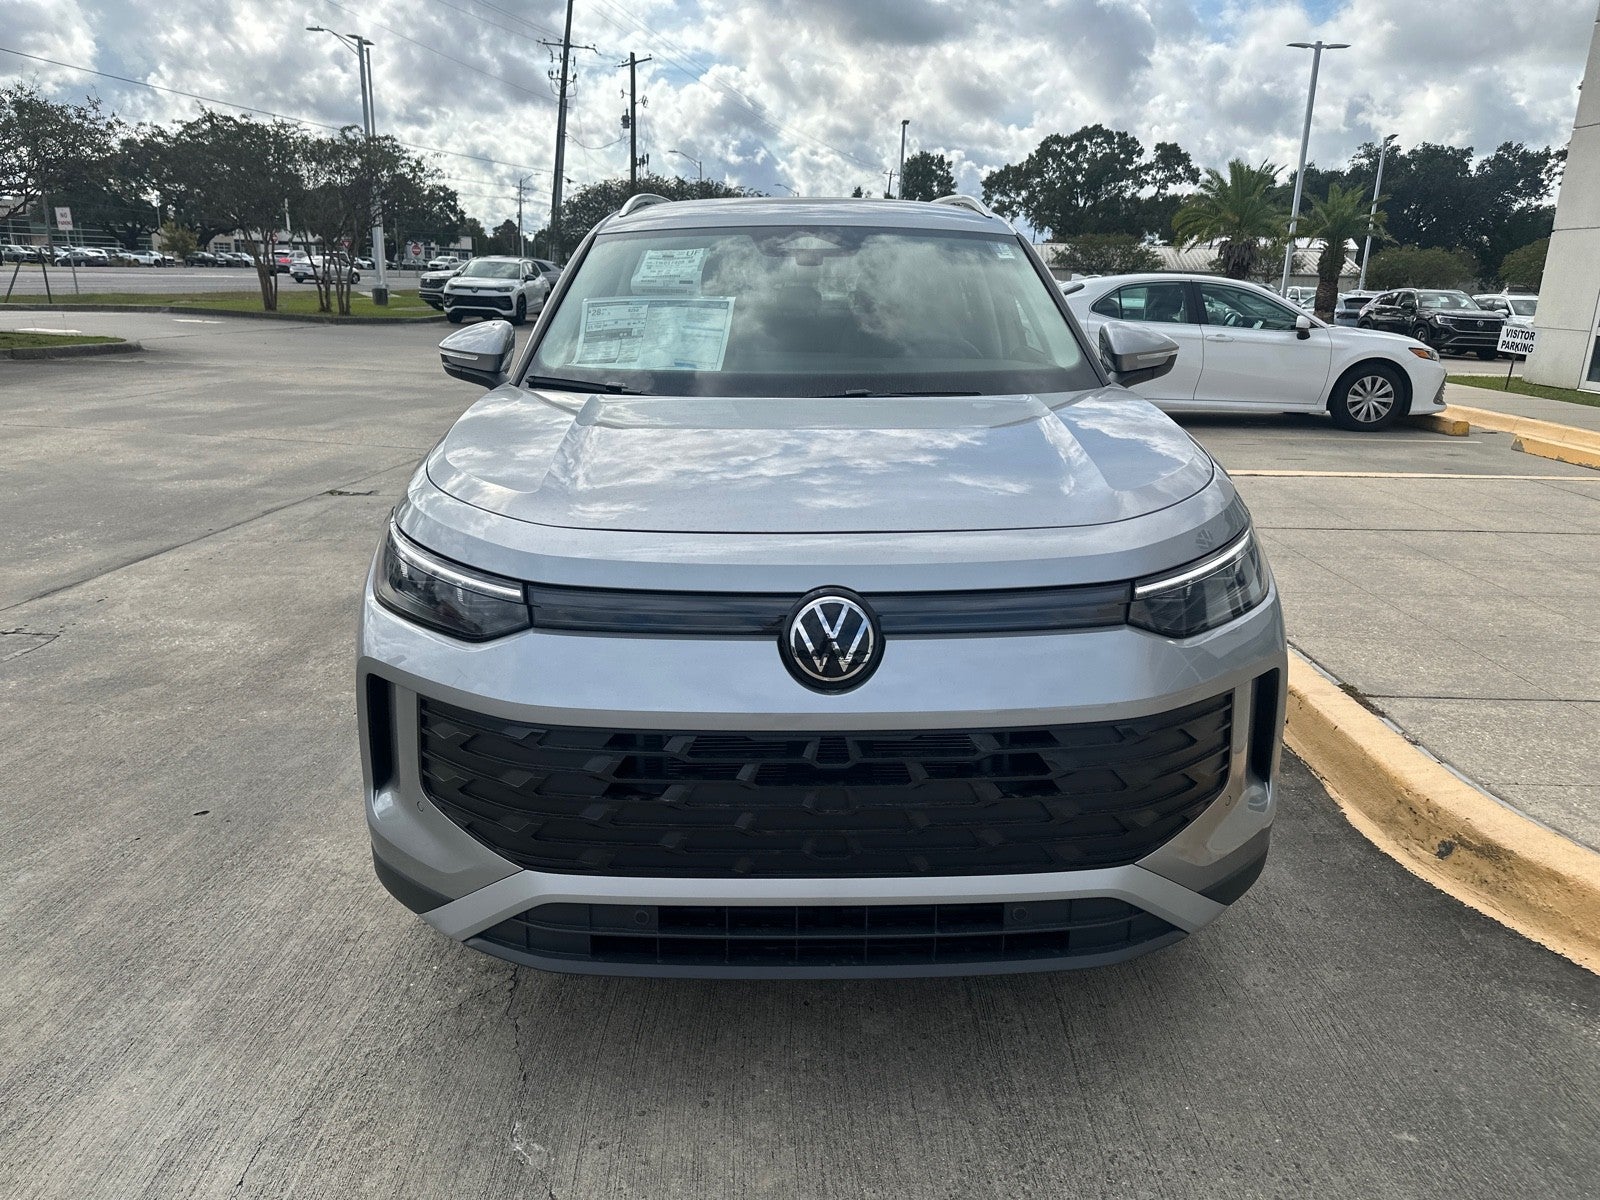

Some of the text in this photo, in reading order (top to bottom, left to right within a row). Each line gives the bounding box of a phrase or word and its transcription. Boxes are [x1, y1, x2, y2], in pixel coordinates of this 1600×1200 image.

[1506, 328, 1535, 341] VISITOR
[1501, 340, 1534, 353] PARKING
[791, 598, 872, 679] VW
